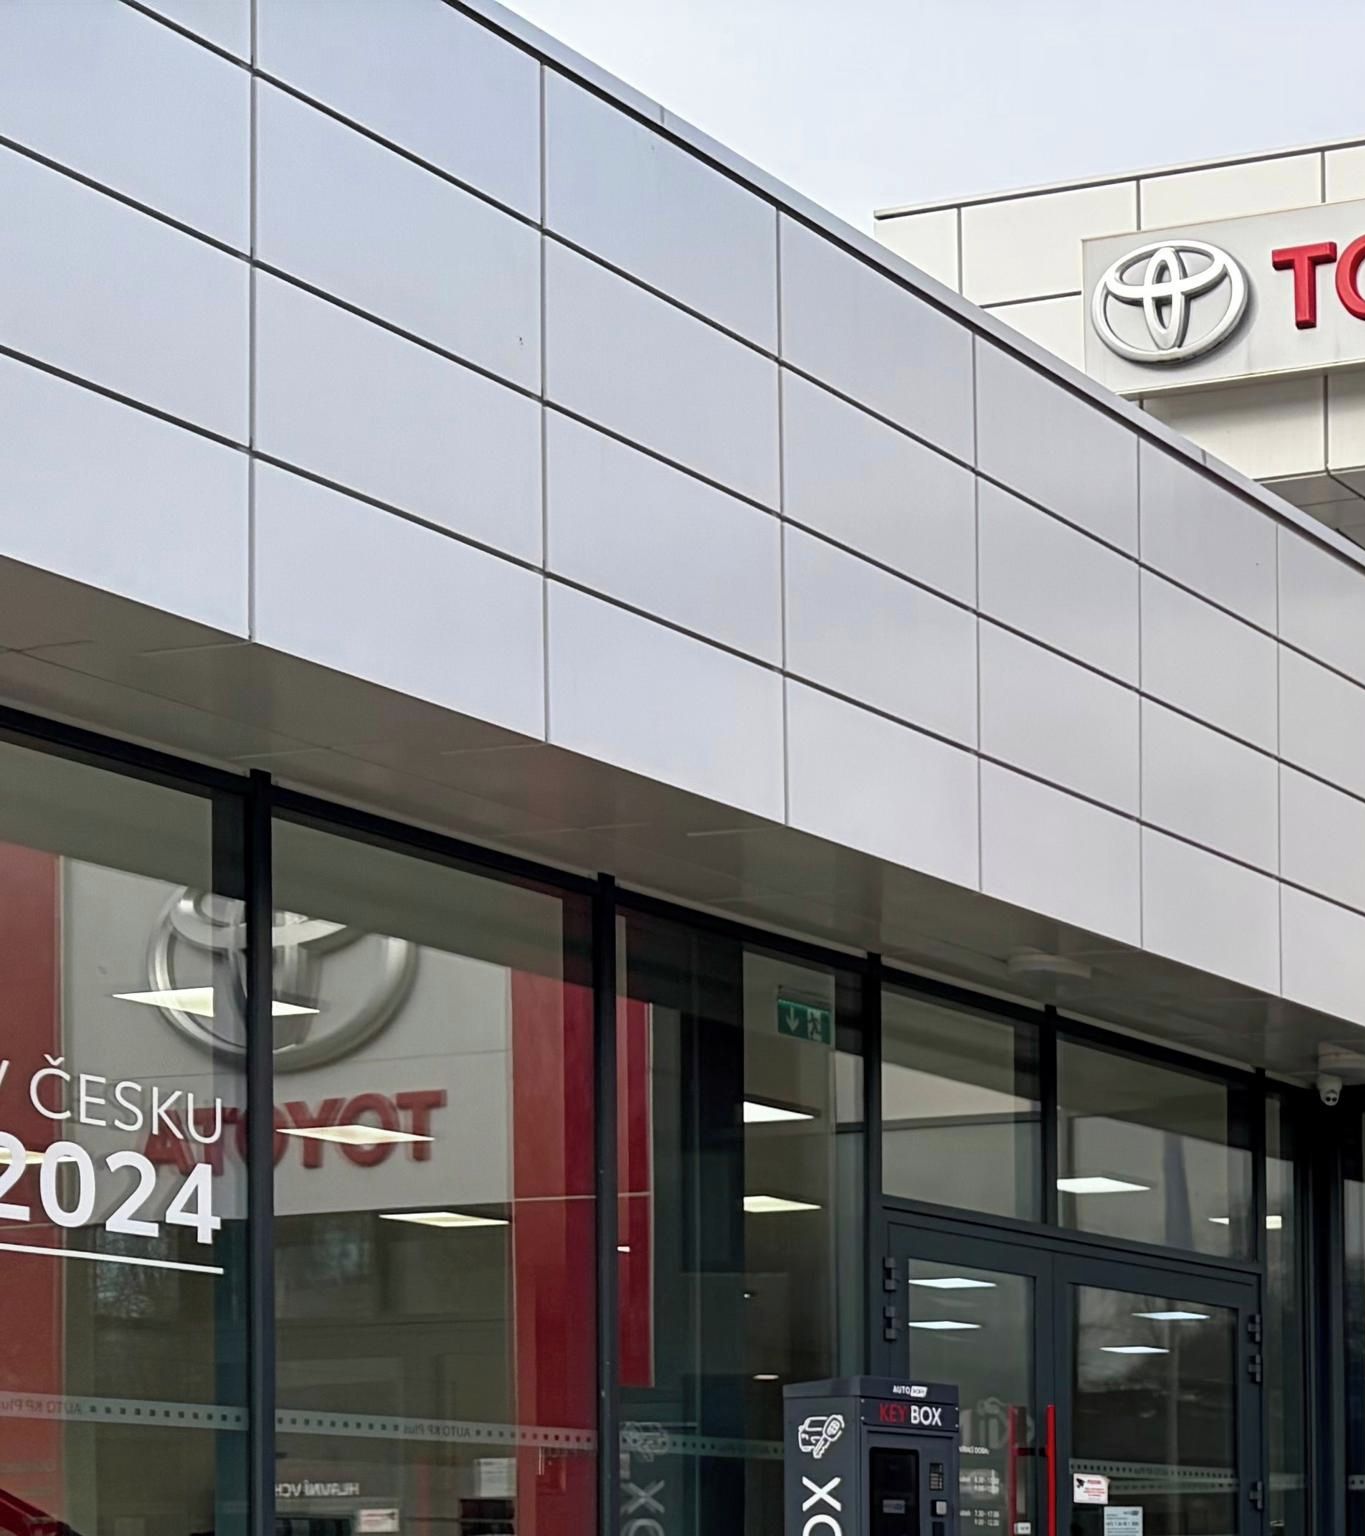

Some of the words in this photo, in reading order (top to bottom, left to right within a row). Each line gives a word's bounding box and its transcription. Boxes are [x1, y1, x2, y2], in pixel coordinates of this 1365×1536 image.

[30, 1054, 221, 1144] ČESKU
[0, 1131, 221, 1244] 2024
[880, 1403, 907, 1424] KEY
[910, 1405, 942, 1427] BOX
